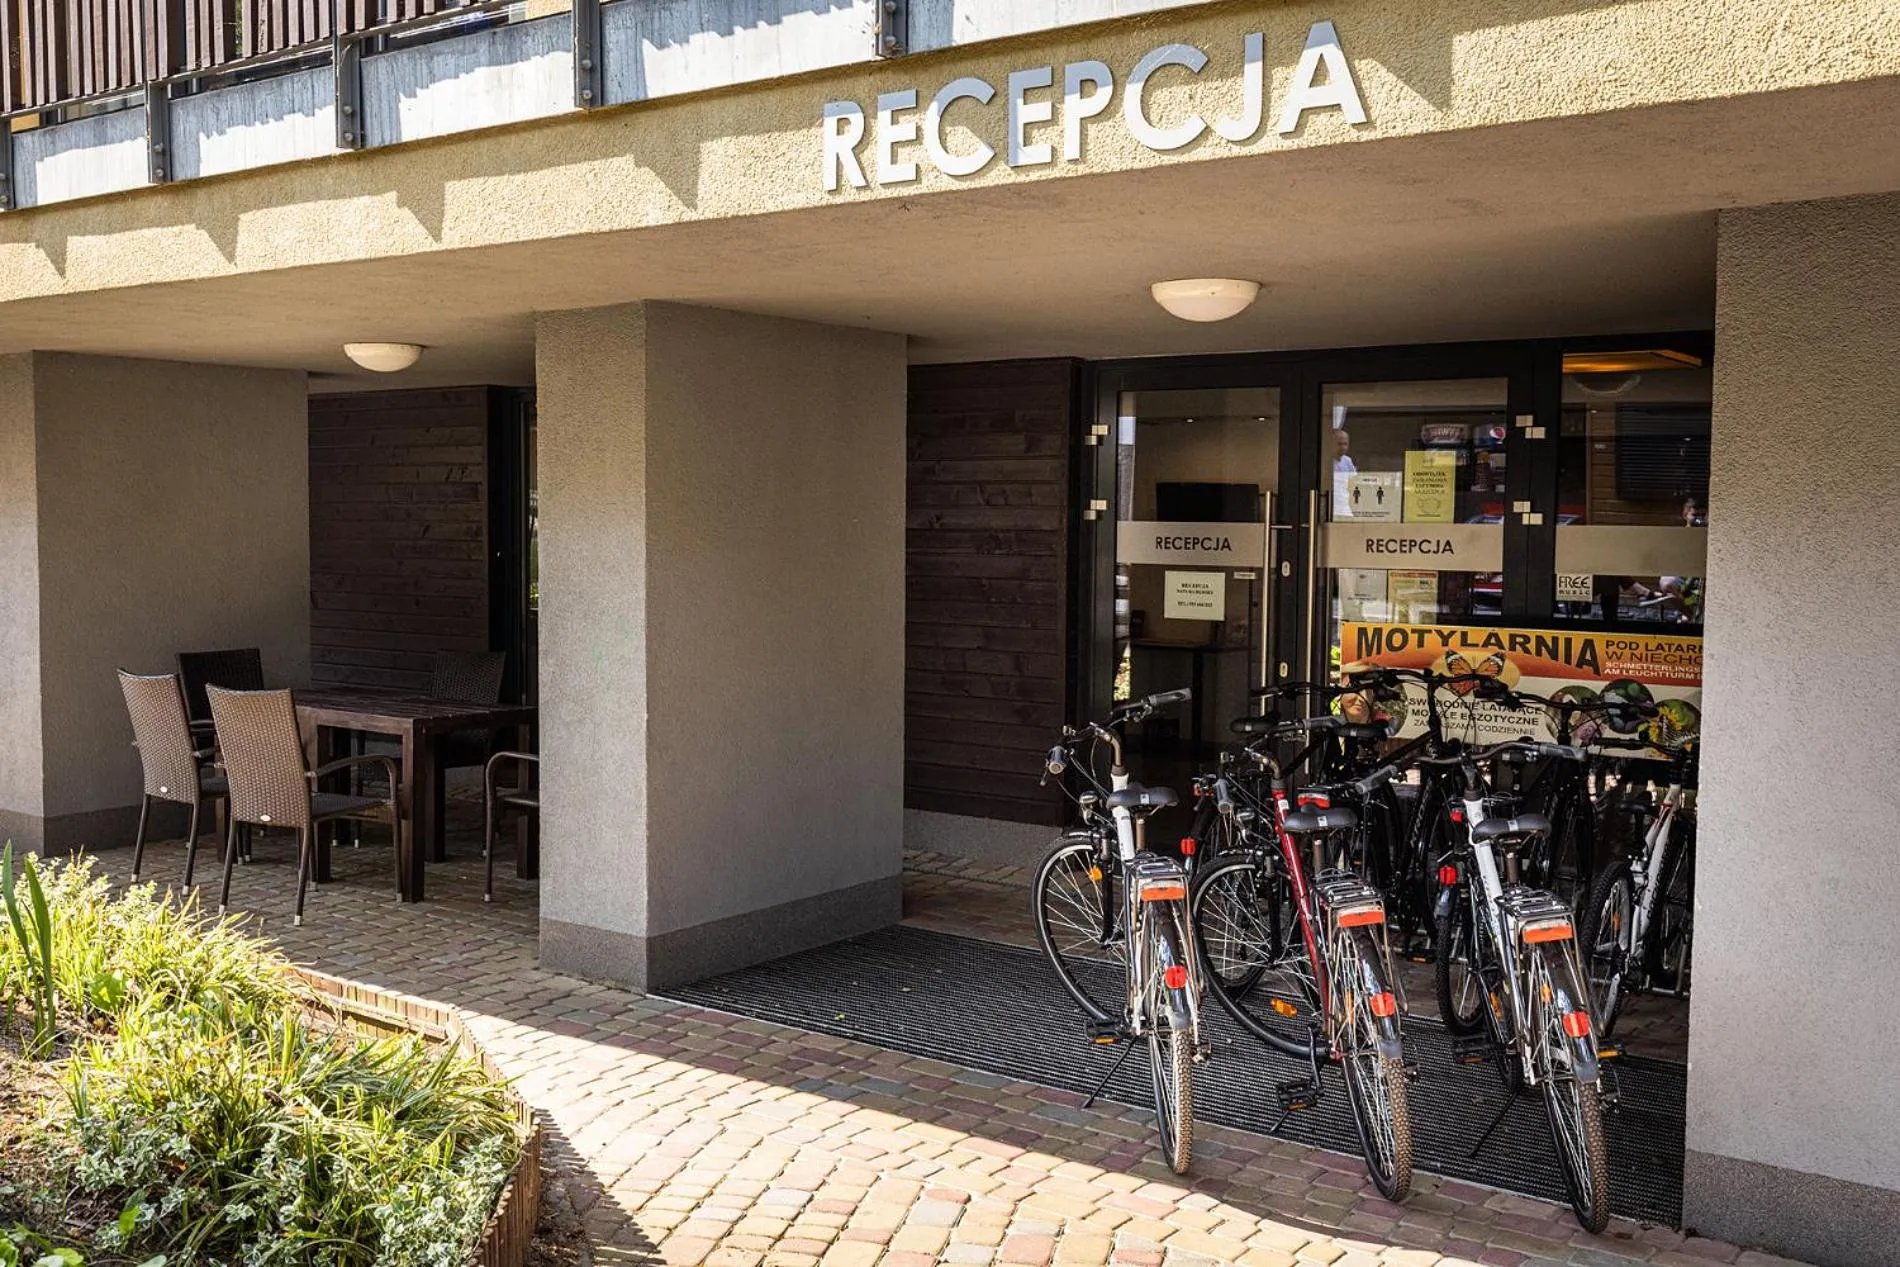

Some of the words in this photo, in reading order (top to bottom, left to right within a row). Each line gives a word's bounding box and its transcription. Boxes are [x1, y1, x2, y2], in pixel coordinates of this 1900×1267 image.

[822, 20, 1367, 192] RECEPCJA
[1155, 536, 1232, 551] RECEPCJA
[1366, 538, 1455, 555] RECEPCJA
[1558, 575, 1591, 589] FREE
[1356, 626, 1601, 677] MOTYLARNIA
[1605, 640, 1640, 651] POD
[1605, 650, 1624, 661] W
[1623, 669, 1695, 680] LEUCHTTURM
[1408, 697, 1478, 711] SWBODNIE
[1460, 712, 1539, 726] EGZOTYCZNE
